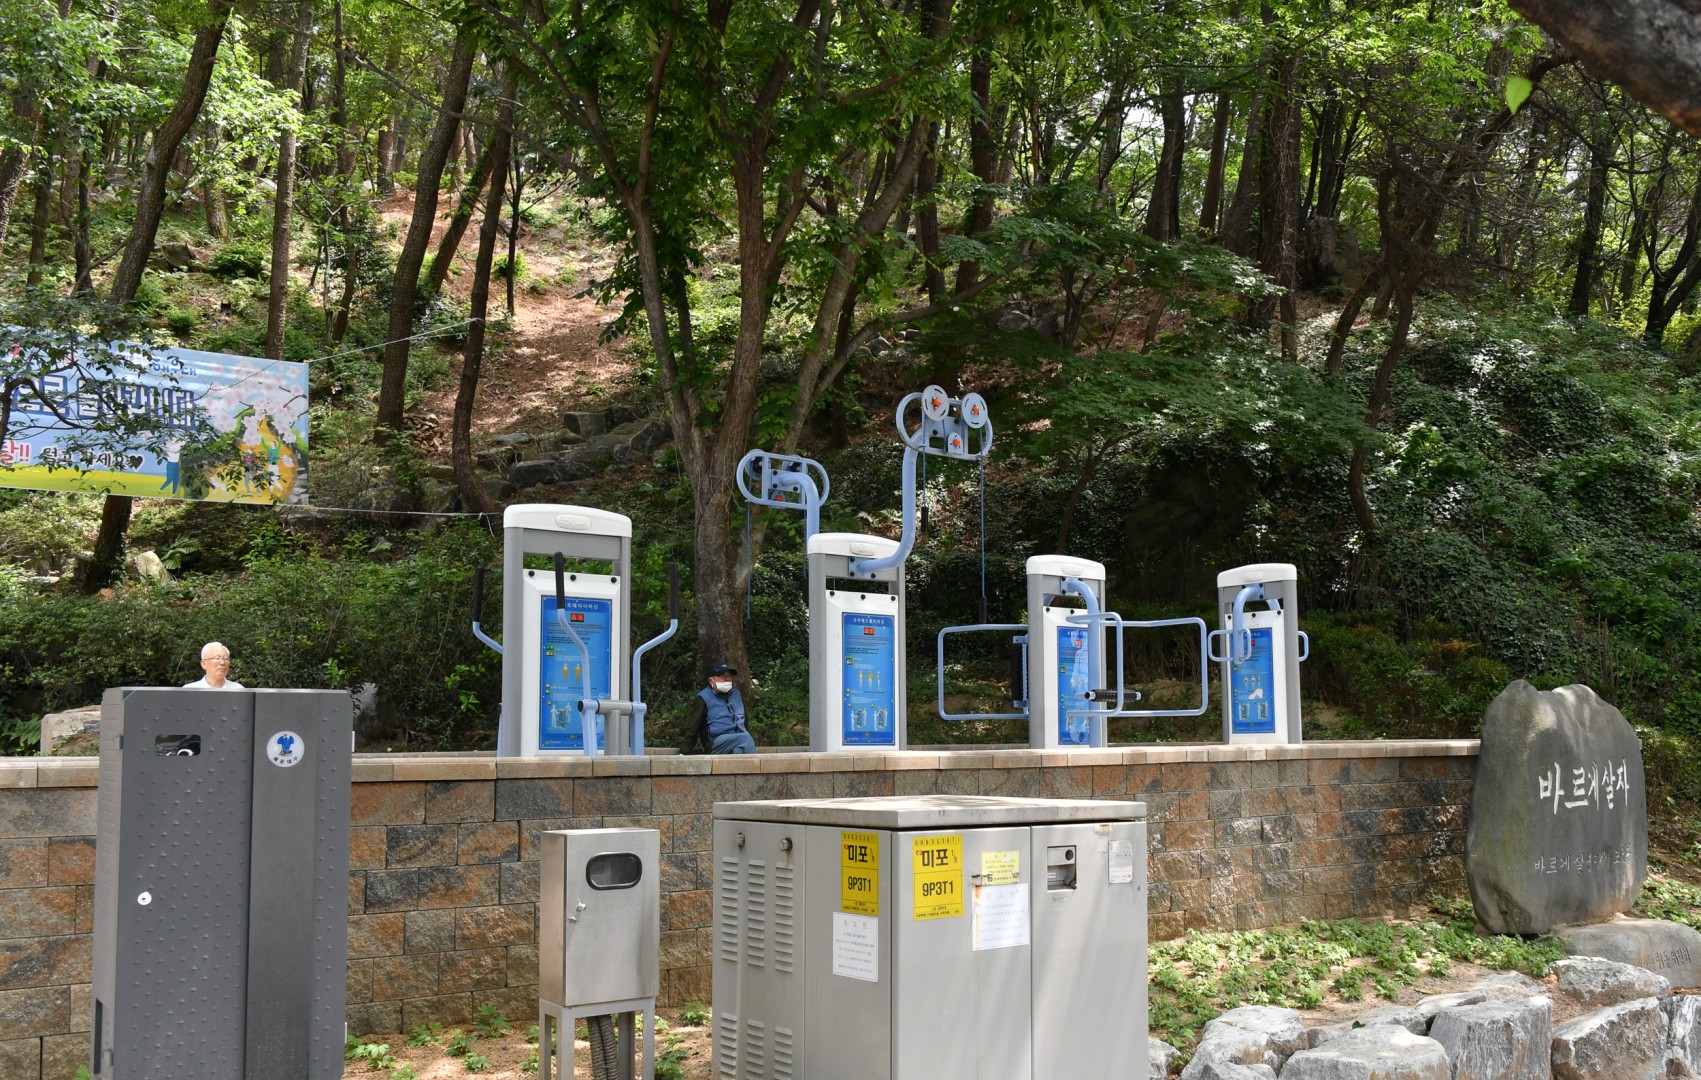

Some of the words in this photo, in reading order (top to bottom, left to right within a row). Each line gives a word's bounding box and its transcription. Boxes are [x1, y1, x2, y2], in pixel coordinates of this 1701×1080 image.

[1538, 758, 1630, 815] 바르게살자
[848, 844, 868, 863] 미포
[922, 848, 949, 867] 미포
[847, 876, 872, 892] 9P3T1
[922, 880, 954, 897] 9P3T1
